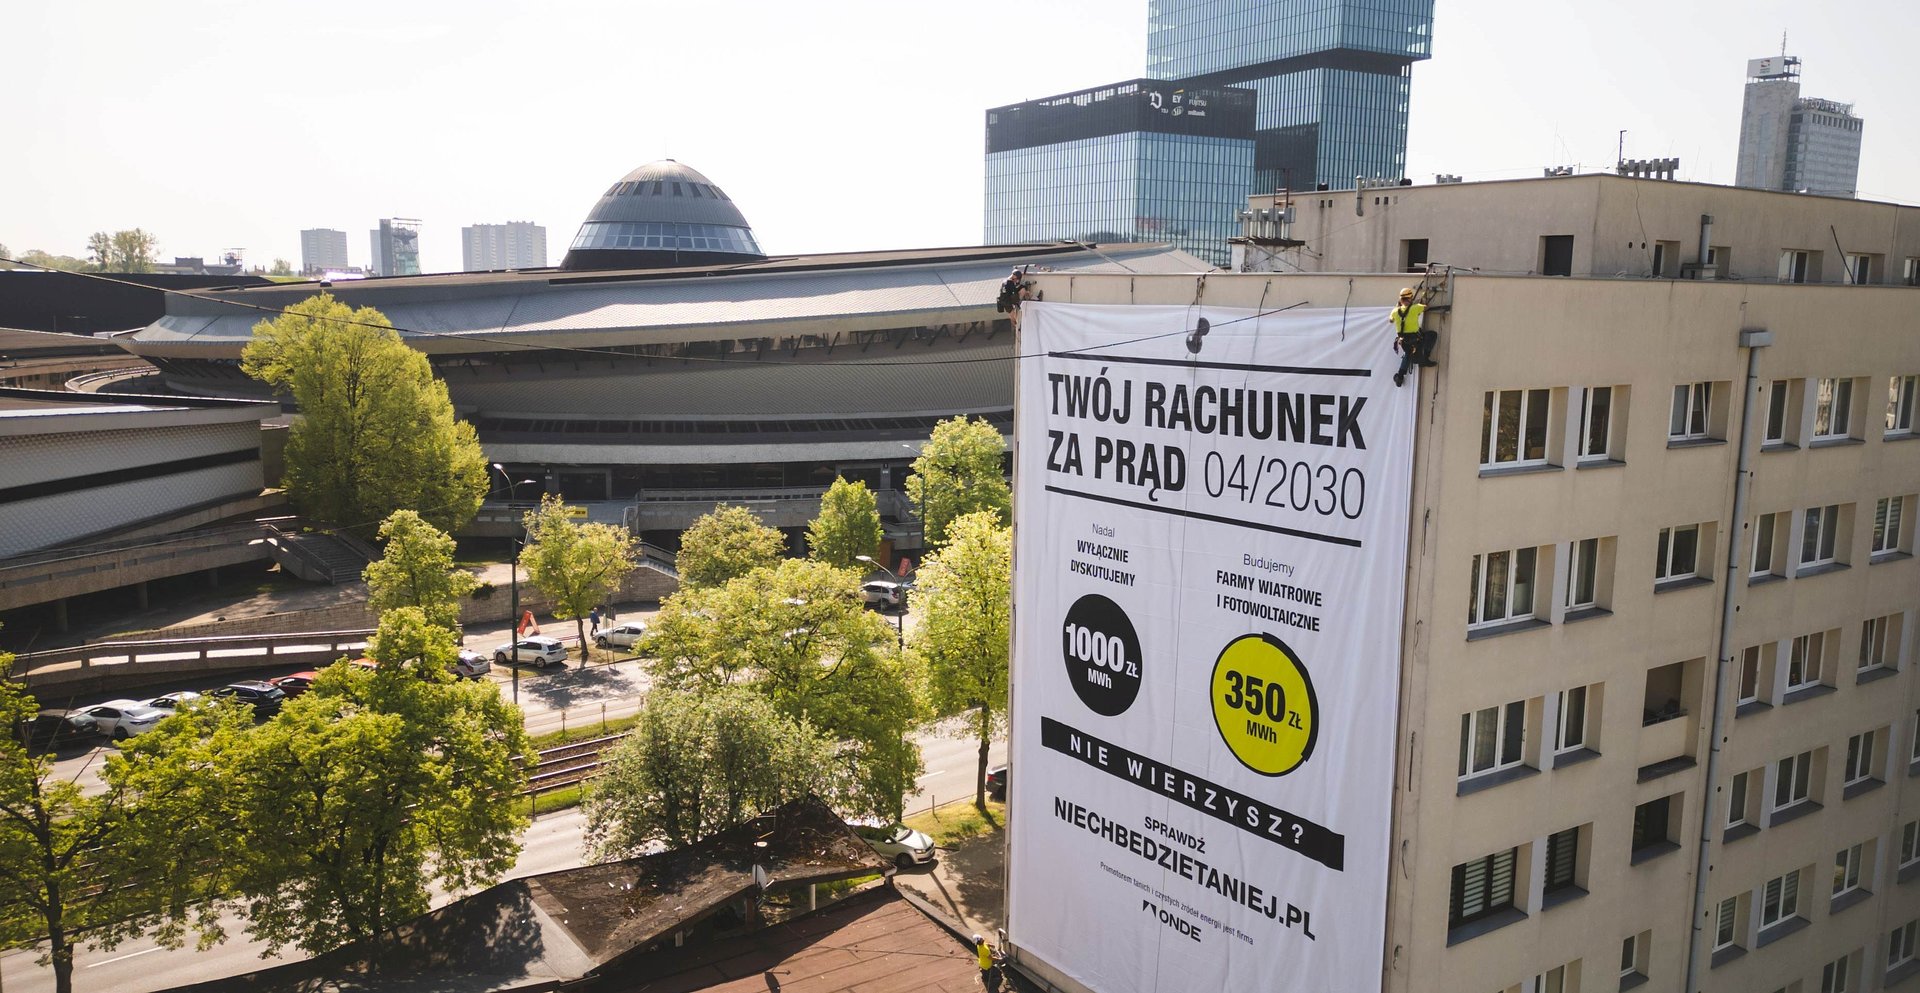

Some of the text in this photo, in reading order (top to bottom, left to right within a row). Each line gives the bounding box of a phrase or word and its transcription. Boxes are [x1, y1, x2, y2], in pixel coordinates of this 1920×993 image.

[1172, 95, 1181, 103] EY
[1188, 99, 1207, 107] FUJITSU
[1048, 366, 1368, 450] TWÓJ RACHUNEK
[1046, 430, 1366, 520] ZA PRĄD 04/2030
[1092, 523, 1115, 538] Nadal
[1077, 539, 1129, 563] WYŁĄCZNIE
[1243, 553, 1295, 577] Budujemy
[1070, 559, 1136, 587] DYSKUTUJEMY
[1216, 570, 1322, 607] FARMY WIATROWE
[1216, 594, 1320, 632] I FOTOWOLTAICZNE
[1065, 622, 1139, 679] 1000 ZŁ
[1087, 667, 1112, 689] MWh
[1224, 669, 1303, 731] 350 ZŁ
[1246, 719, 1277, 744] MWh
[1070, 733, 1305, 845] NIE WIERZYSZ?
[1144, 815, 1206, 855] SPRAWDŹ
[1054, 796, 1316, 942] NIECHBEDZIETANIEJ.PL
[1100, 861, 1132, 884] Promotorem
[1133, 878, 1151, 893] tanich
[1155, 890, 1180, 908] czystych
[1200, 913, 1222, 929] energii
[1222, 922, 1235, 937] jest
[1159, 909, 1202, 943] ONDE
